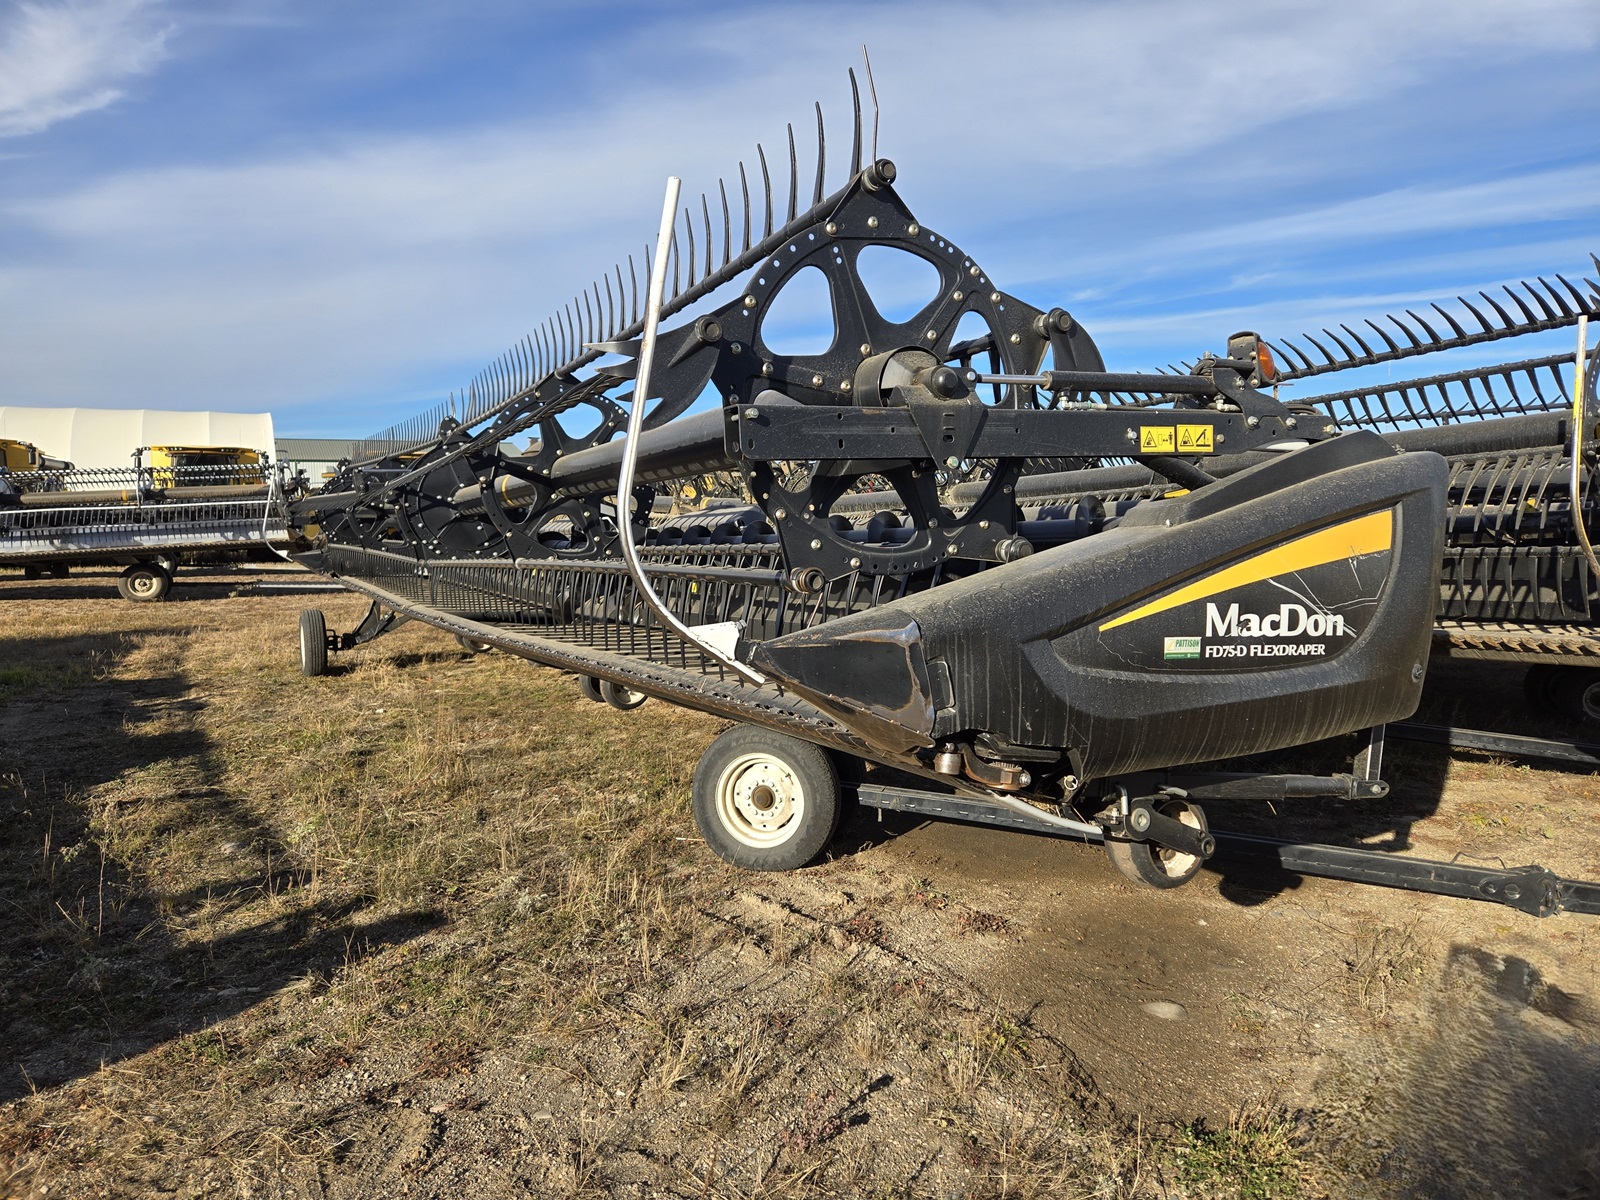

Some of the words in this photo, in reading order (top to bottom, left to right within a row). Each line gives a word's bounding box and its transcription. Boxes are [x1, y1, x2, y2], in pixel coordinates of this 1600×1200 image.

[1205, 602, 1344, 637] MacDon
[1205, 645, 1247, 658] FD75-D
[1250, 644, 1326, 657] FLEXDRAPER
